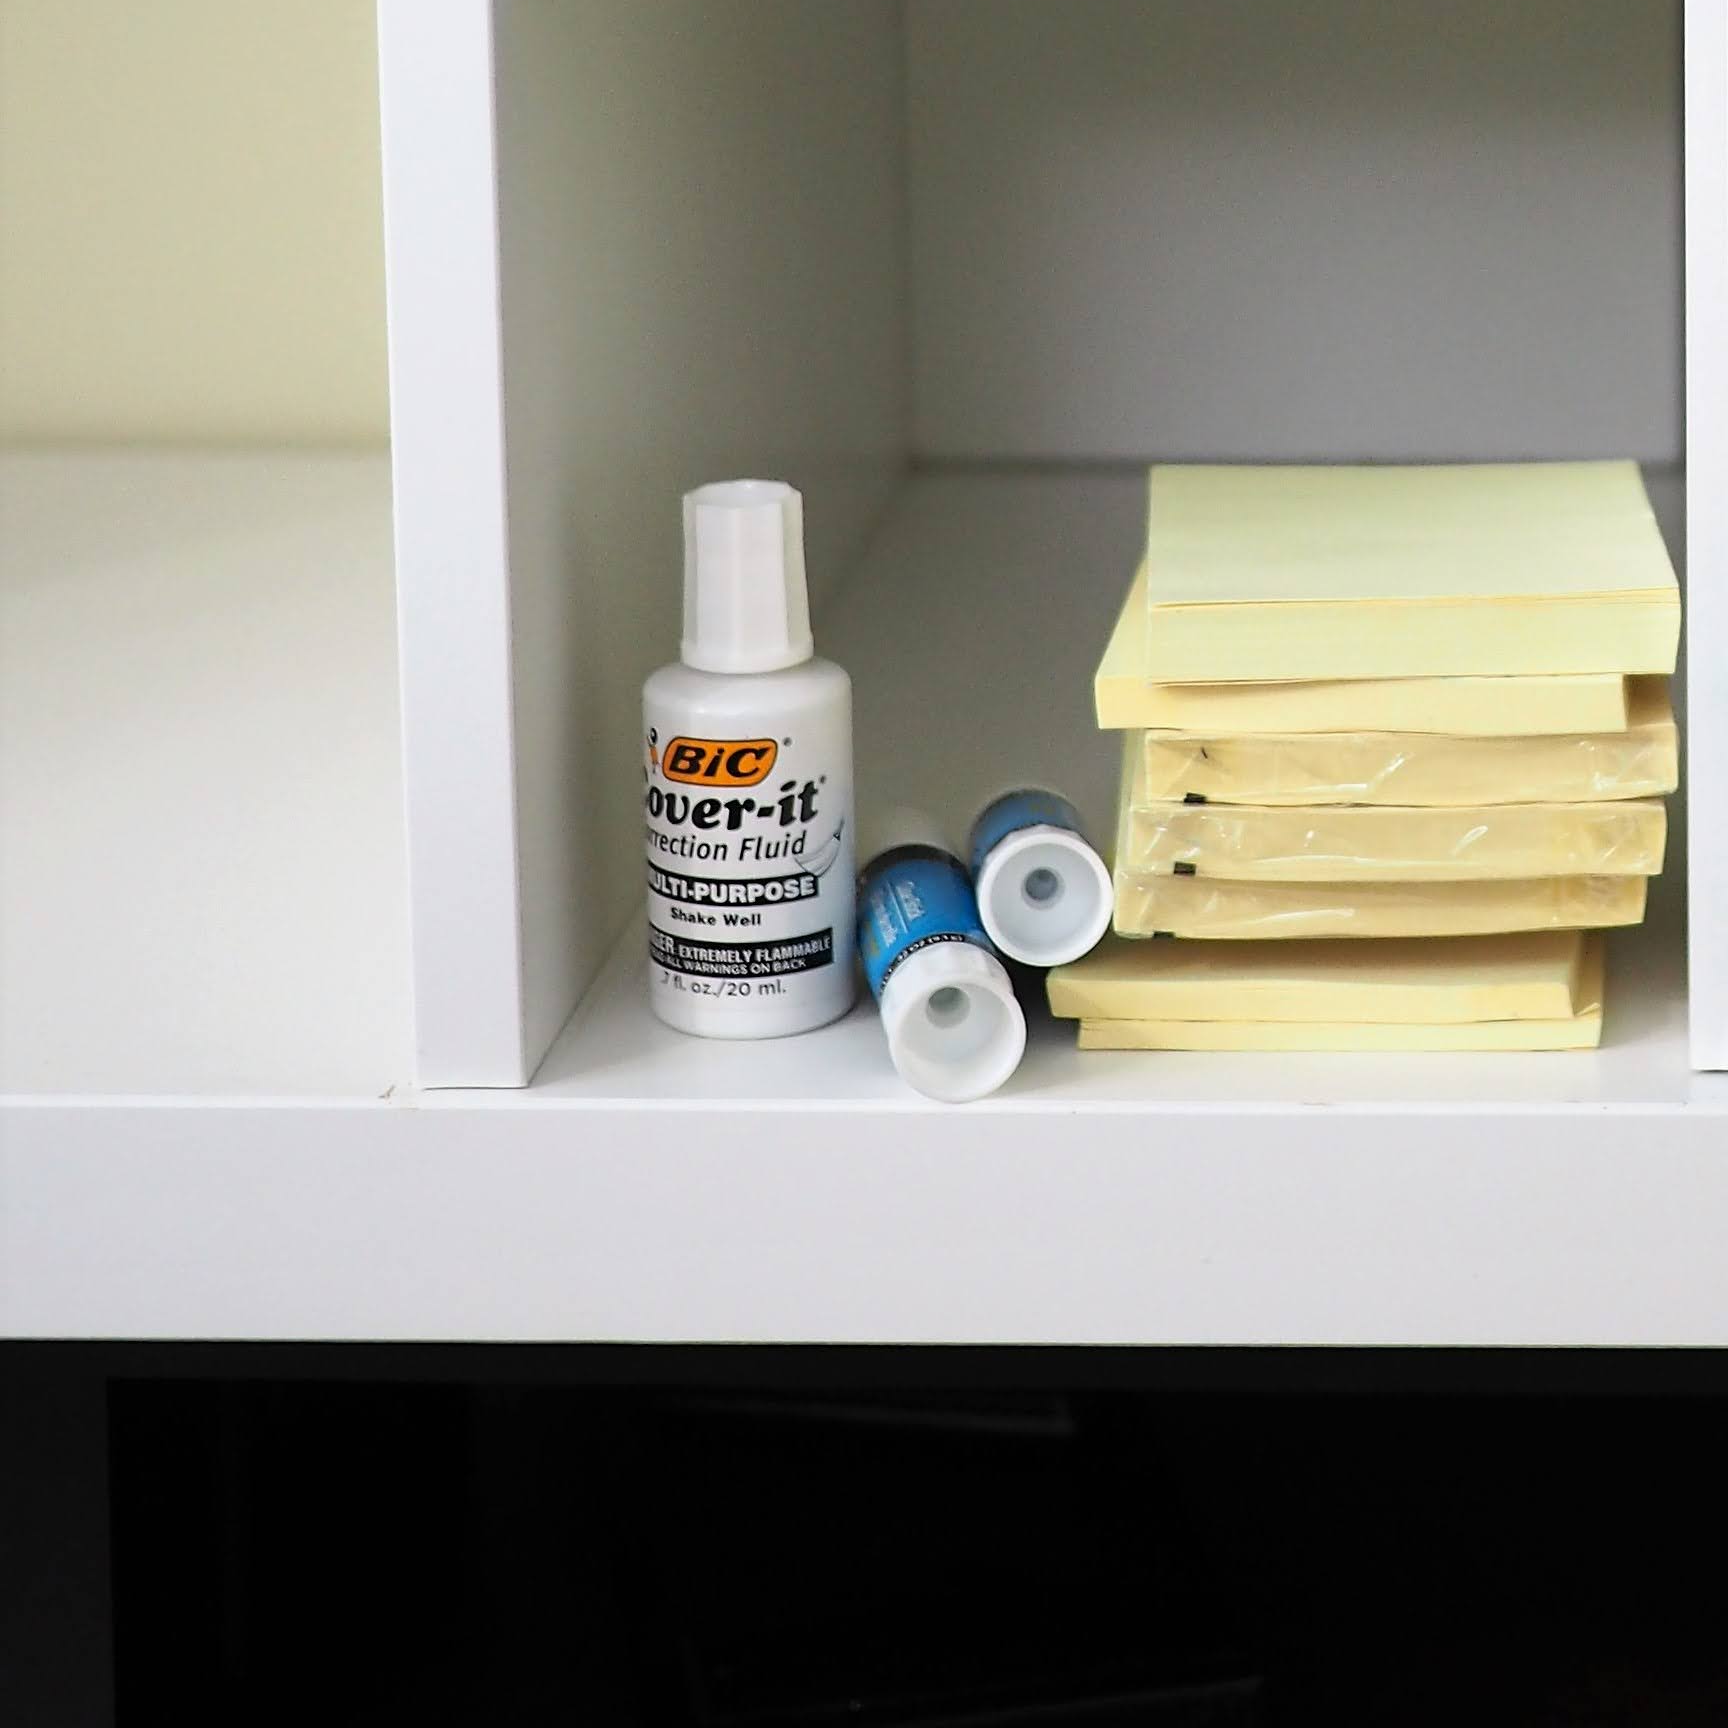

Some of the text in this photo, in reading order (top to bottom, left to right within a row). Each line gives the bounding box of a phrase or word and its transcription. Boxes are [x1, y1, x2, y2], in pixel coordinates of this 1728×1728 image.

[646, 779, 819, 831] over-it
[739, 830, 807, 861] Fluid
[651, 871, 816, 904] ULTI-PURPOSE
[671, 907, 761, 927] Shake Well
[678, 945, 752, 963] EXTREMELY
[755, 936, 831, 962] FLAMMABLE
[684, 961, 748, 975] WARNINGS
[750, 962, 770, 974] ON
[773, 958, 806, 972] BACK
[759, 978, 786, 995] ml.
